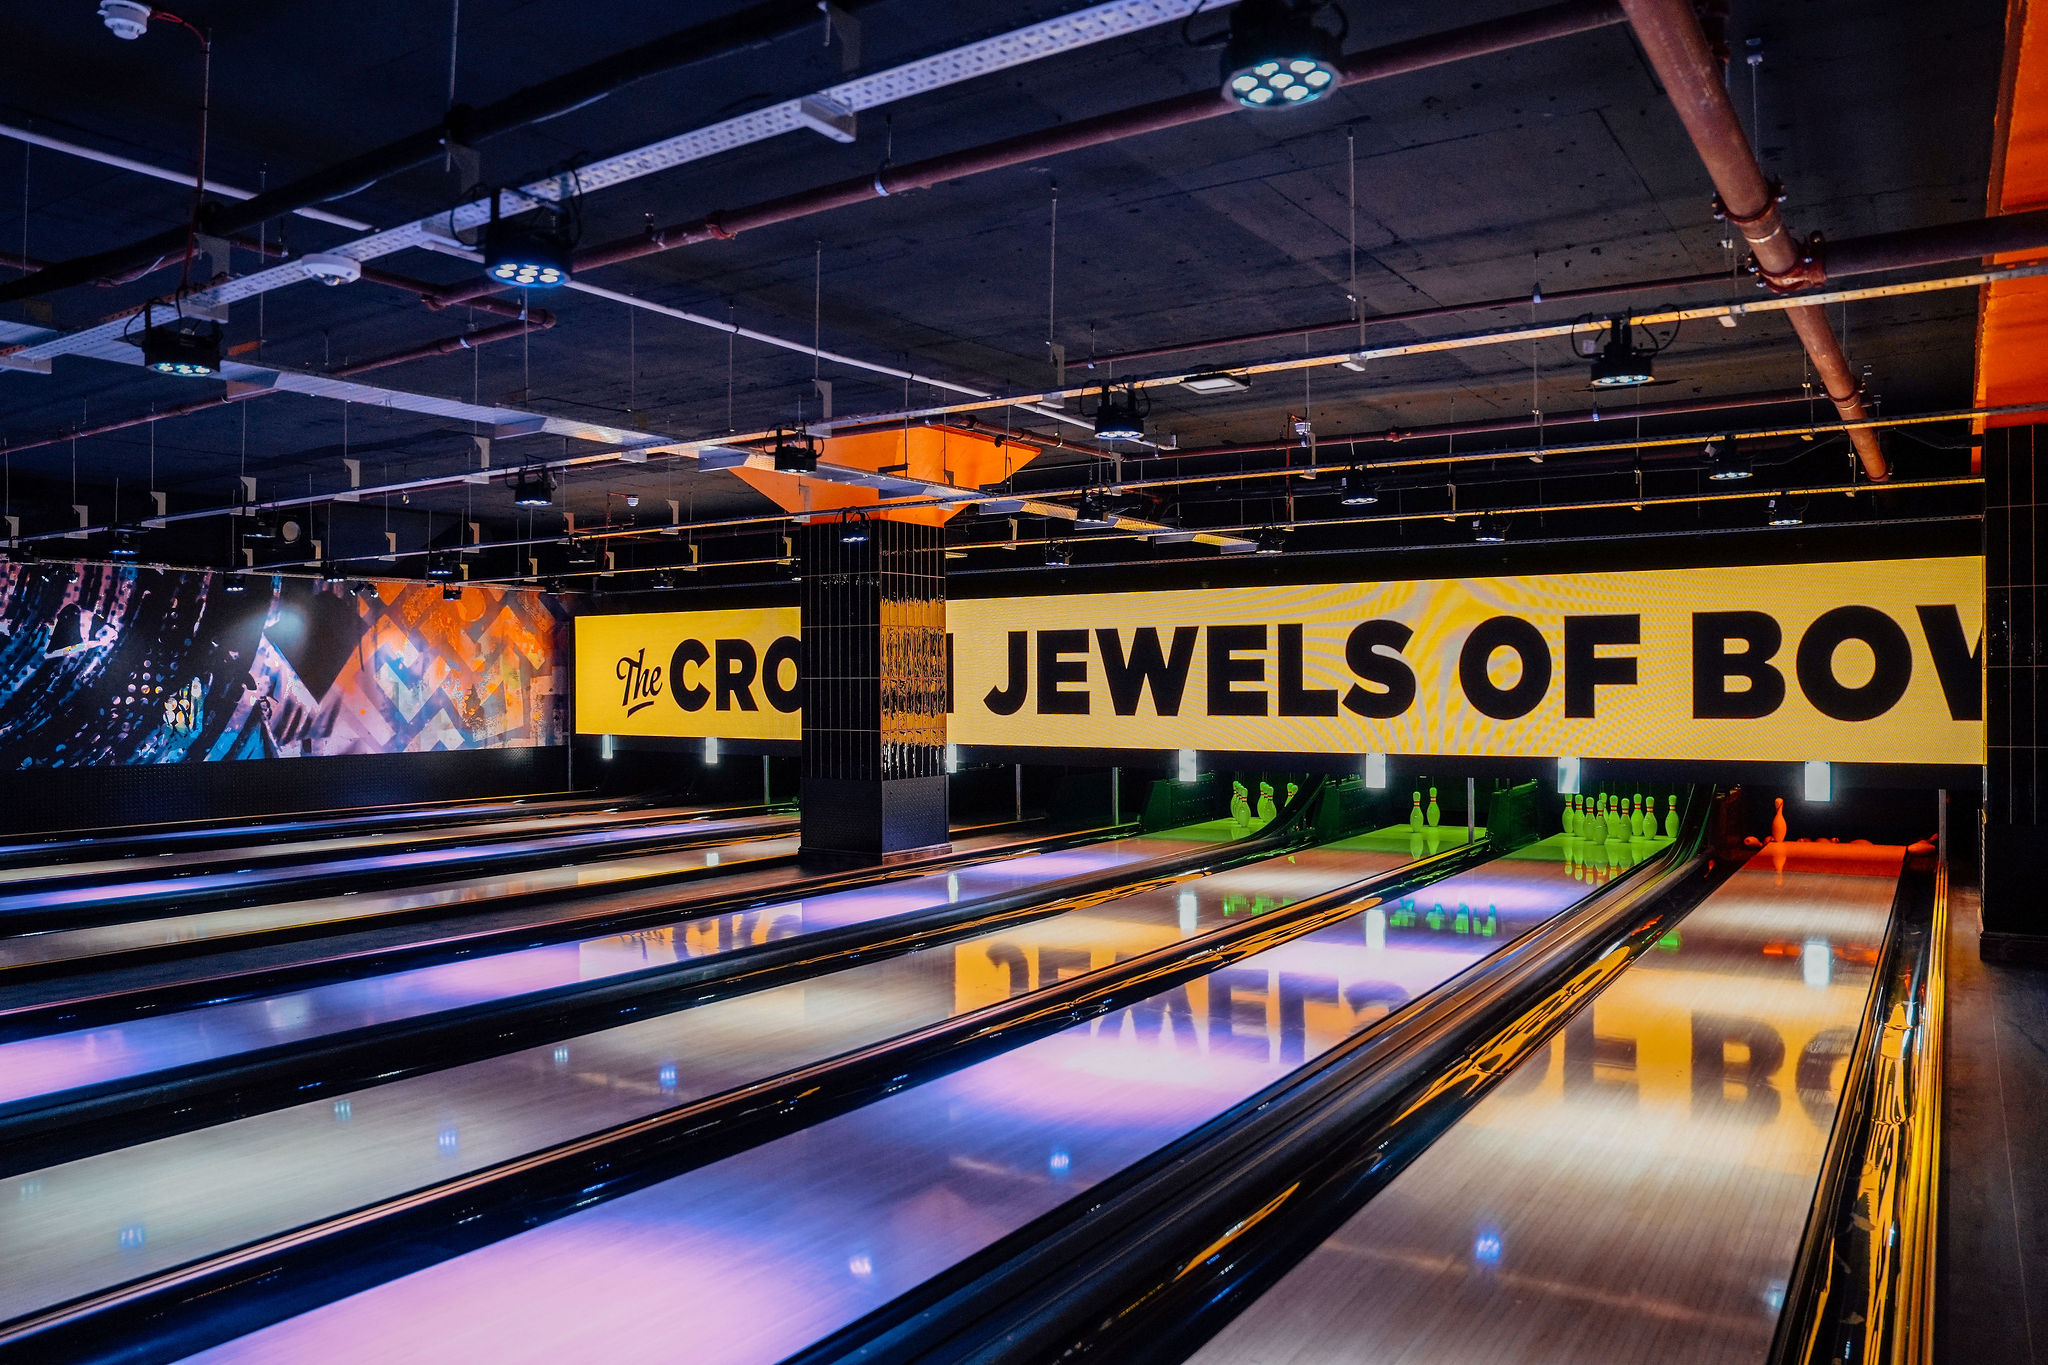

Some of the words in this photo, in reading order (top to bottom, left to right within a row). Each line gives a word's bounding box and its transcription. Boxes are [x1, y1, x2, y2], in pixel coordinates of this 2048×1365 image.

[616, 648, 663, 706] The
[983, 619, 1416, 719] JEWELS
[1458, 613, 1641, 720] OF
